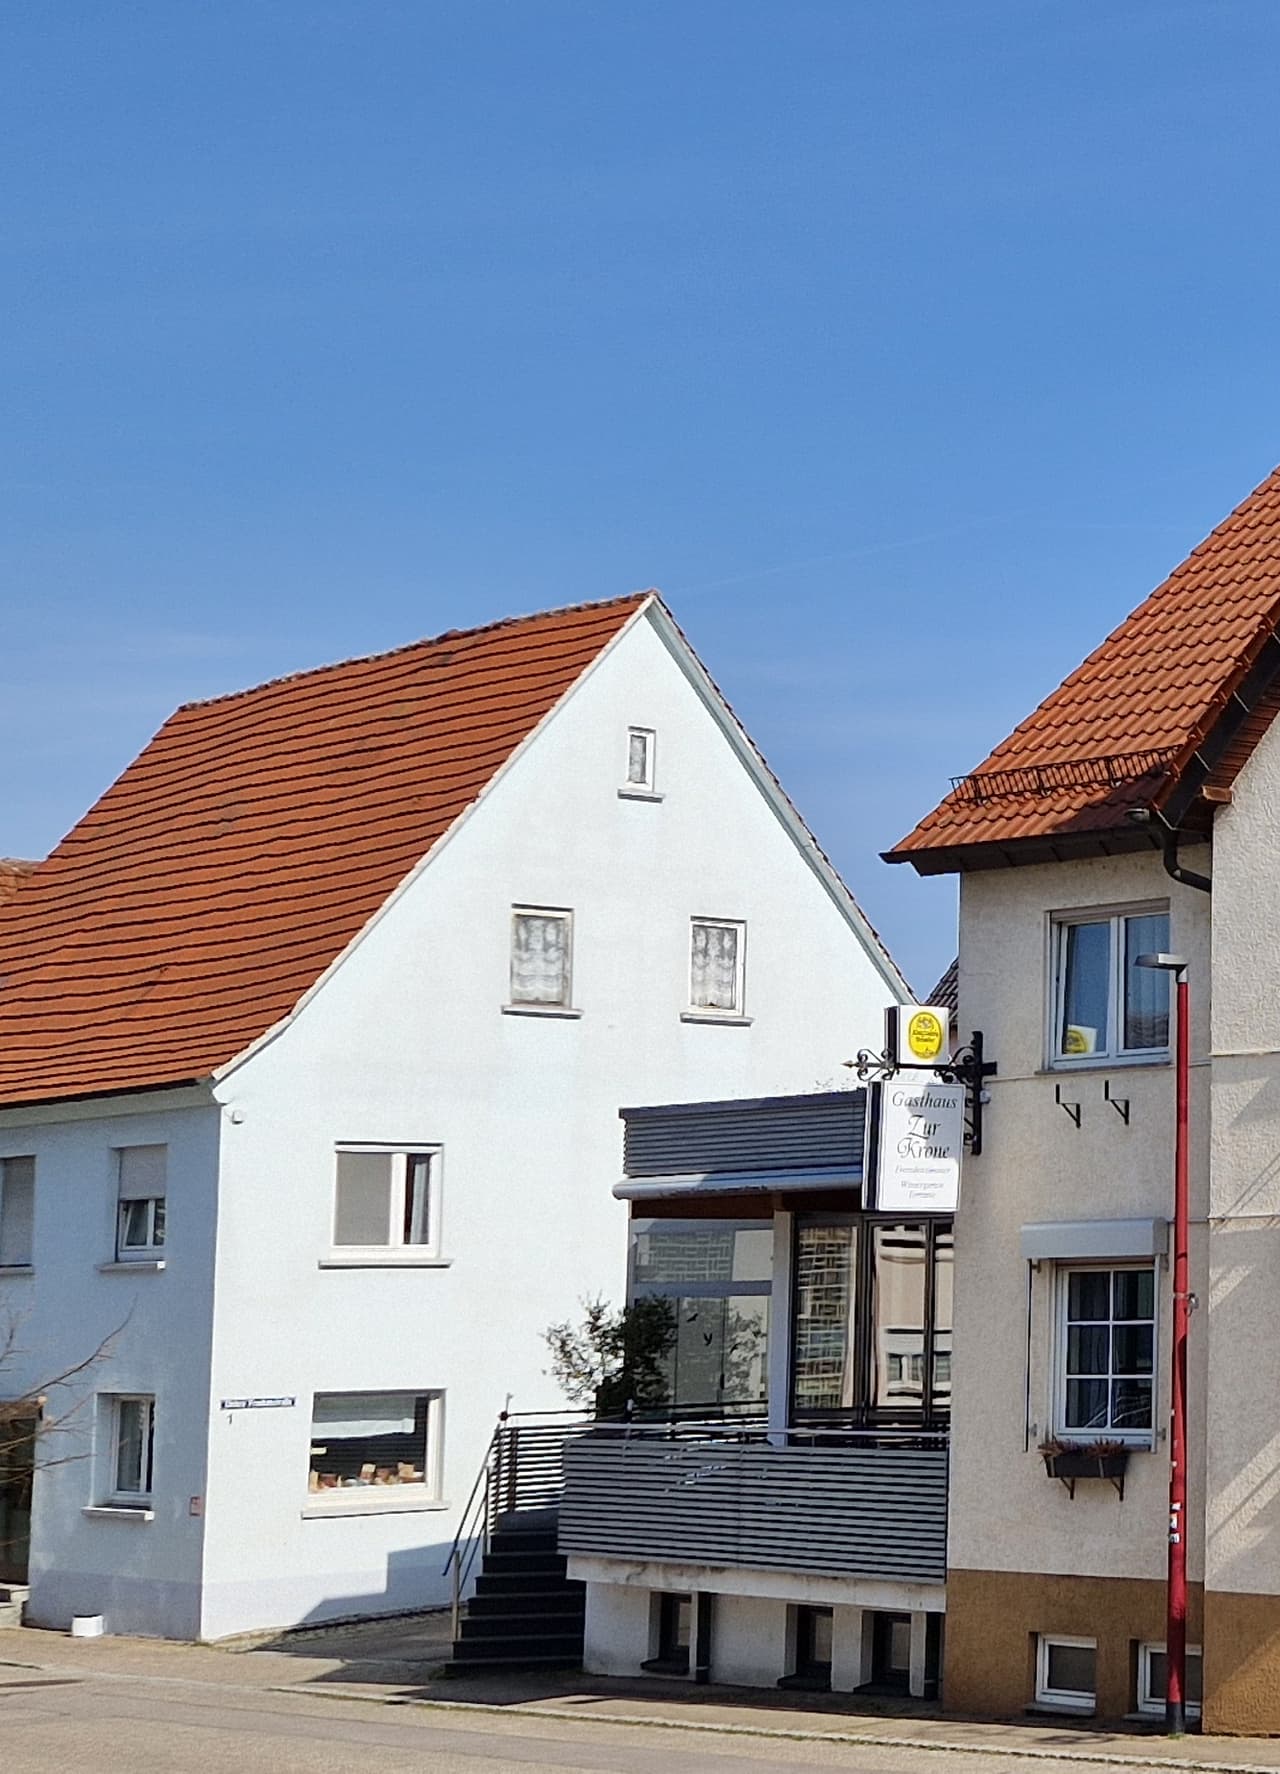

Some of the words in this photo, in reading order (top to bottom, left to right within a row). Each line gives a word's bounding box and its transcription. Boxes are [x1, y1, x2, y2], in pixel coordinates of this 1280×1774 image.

[892, 1090, 958, 1109] Gasthaus
[908, 1114, 941, 1140] Zur
[897, 1137, 950, 1159] Krone
